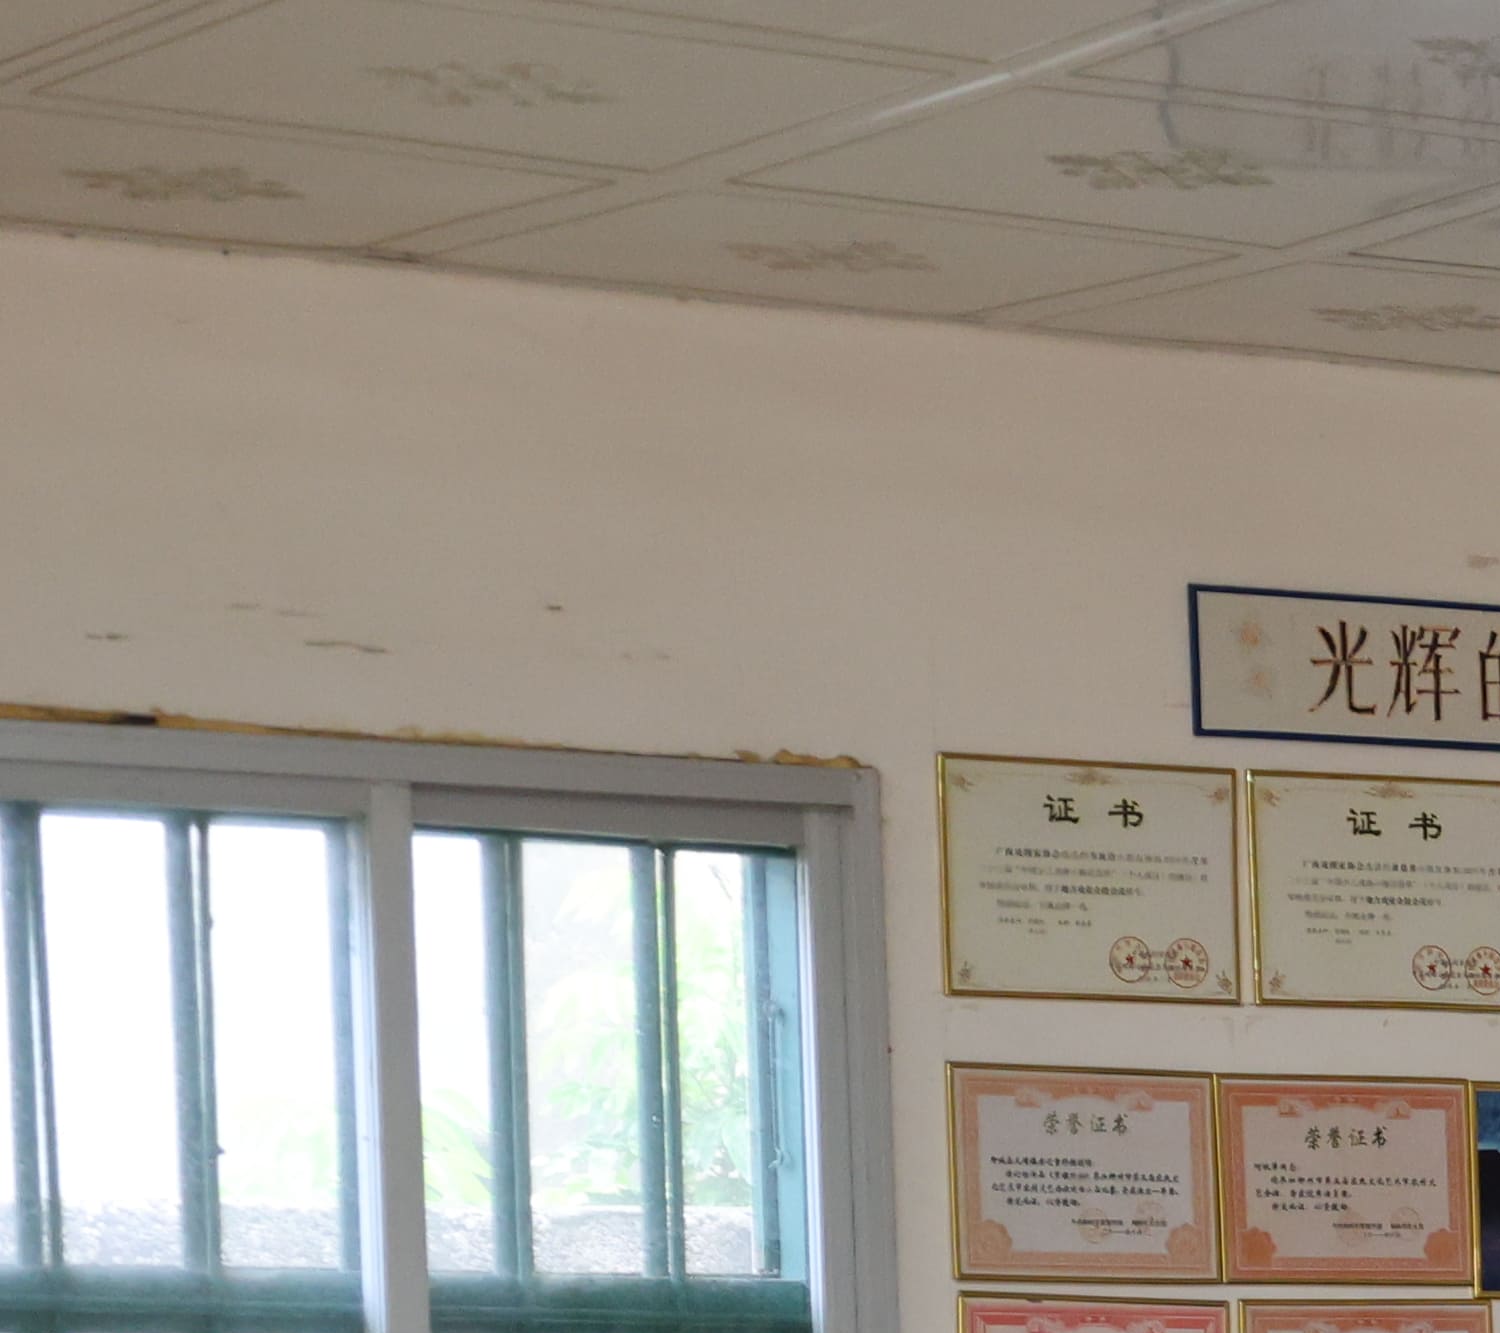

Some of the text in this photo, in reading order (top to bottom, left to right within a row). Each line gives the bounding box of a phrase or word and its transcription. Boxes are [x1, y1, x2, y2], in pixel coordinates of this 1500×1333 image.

[1043, 794, 1144, 828] 证书
[1347, 808, 1442, 841] 证书
[1043, 1111, 1129, 1136] 荣誉证书
[1304, 1126, 1388, 1150] 荣誉证书
